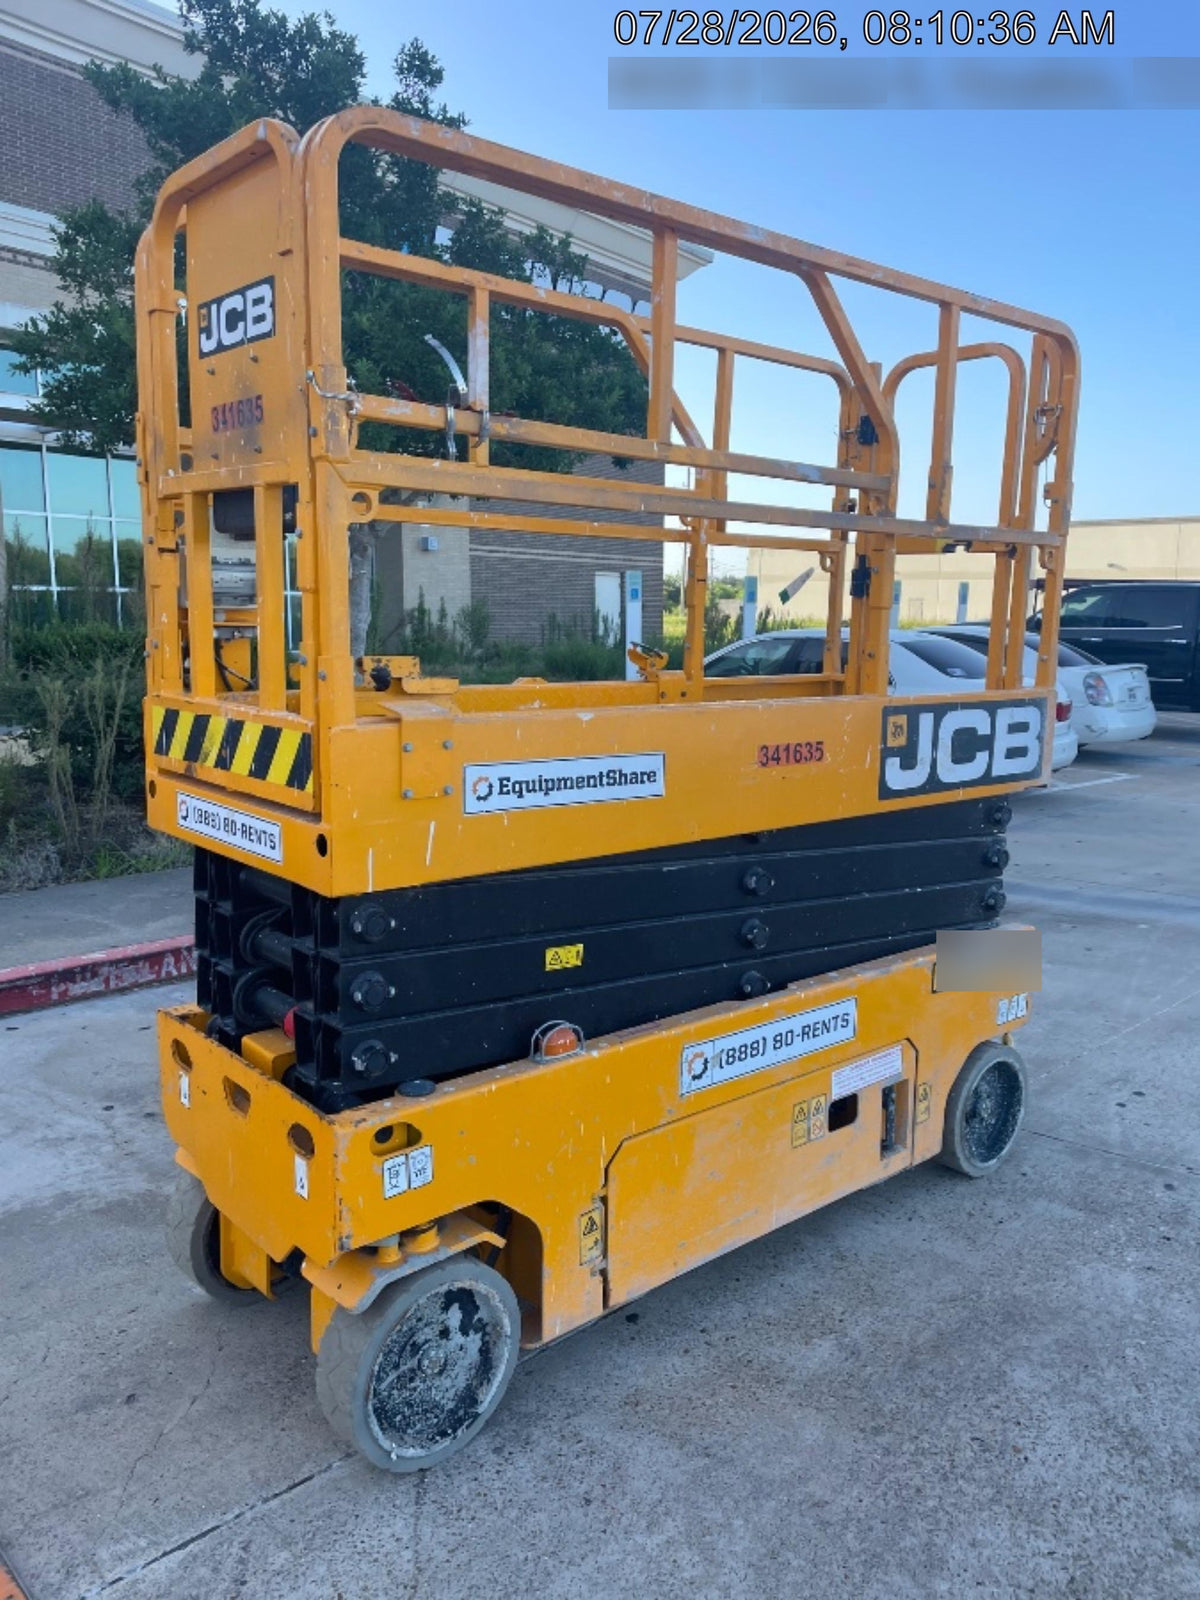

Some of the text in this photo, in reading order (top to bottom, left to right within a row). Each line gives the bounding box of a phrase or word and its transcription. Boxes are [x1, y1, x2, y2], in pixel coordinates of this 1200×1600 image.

[200, 283, 274, 353] JCB
[210, 394, 264, 433] 341635
[759, 741, 824, 767] 341635
[885, 705, 1042, 790] JCB
[498, 769, 657, 799] EquipmentShare
[718, 1012, 850, 1070] (888) 80-RENTS
